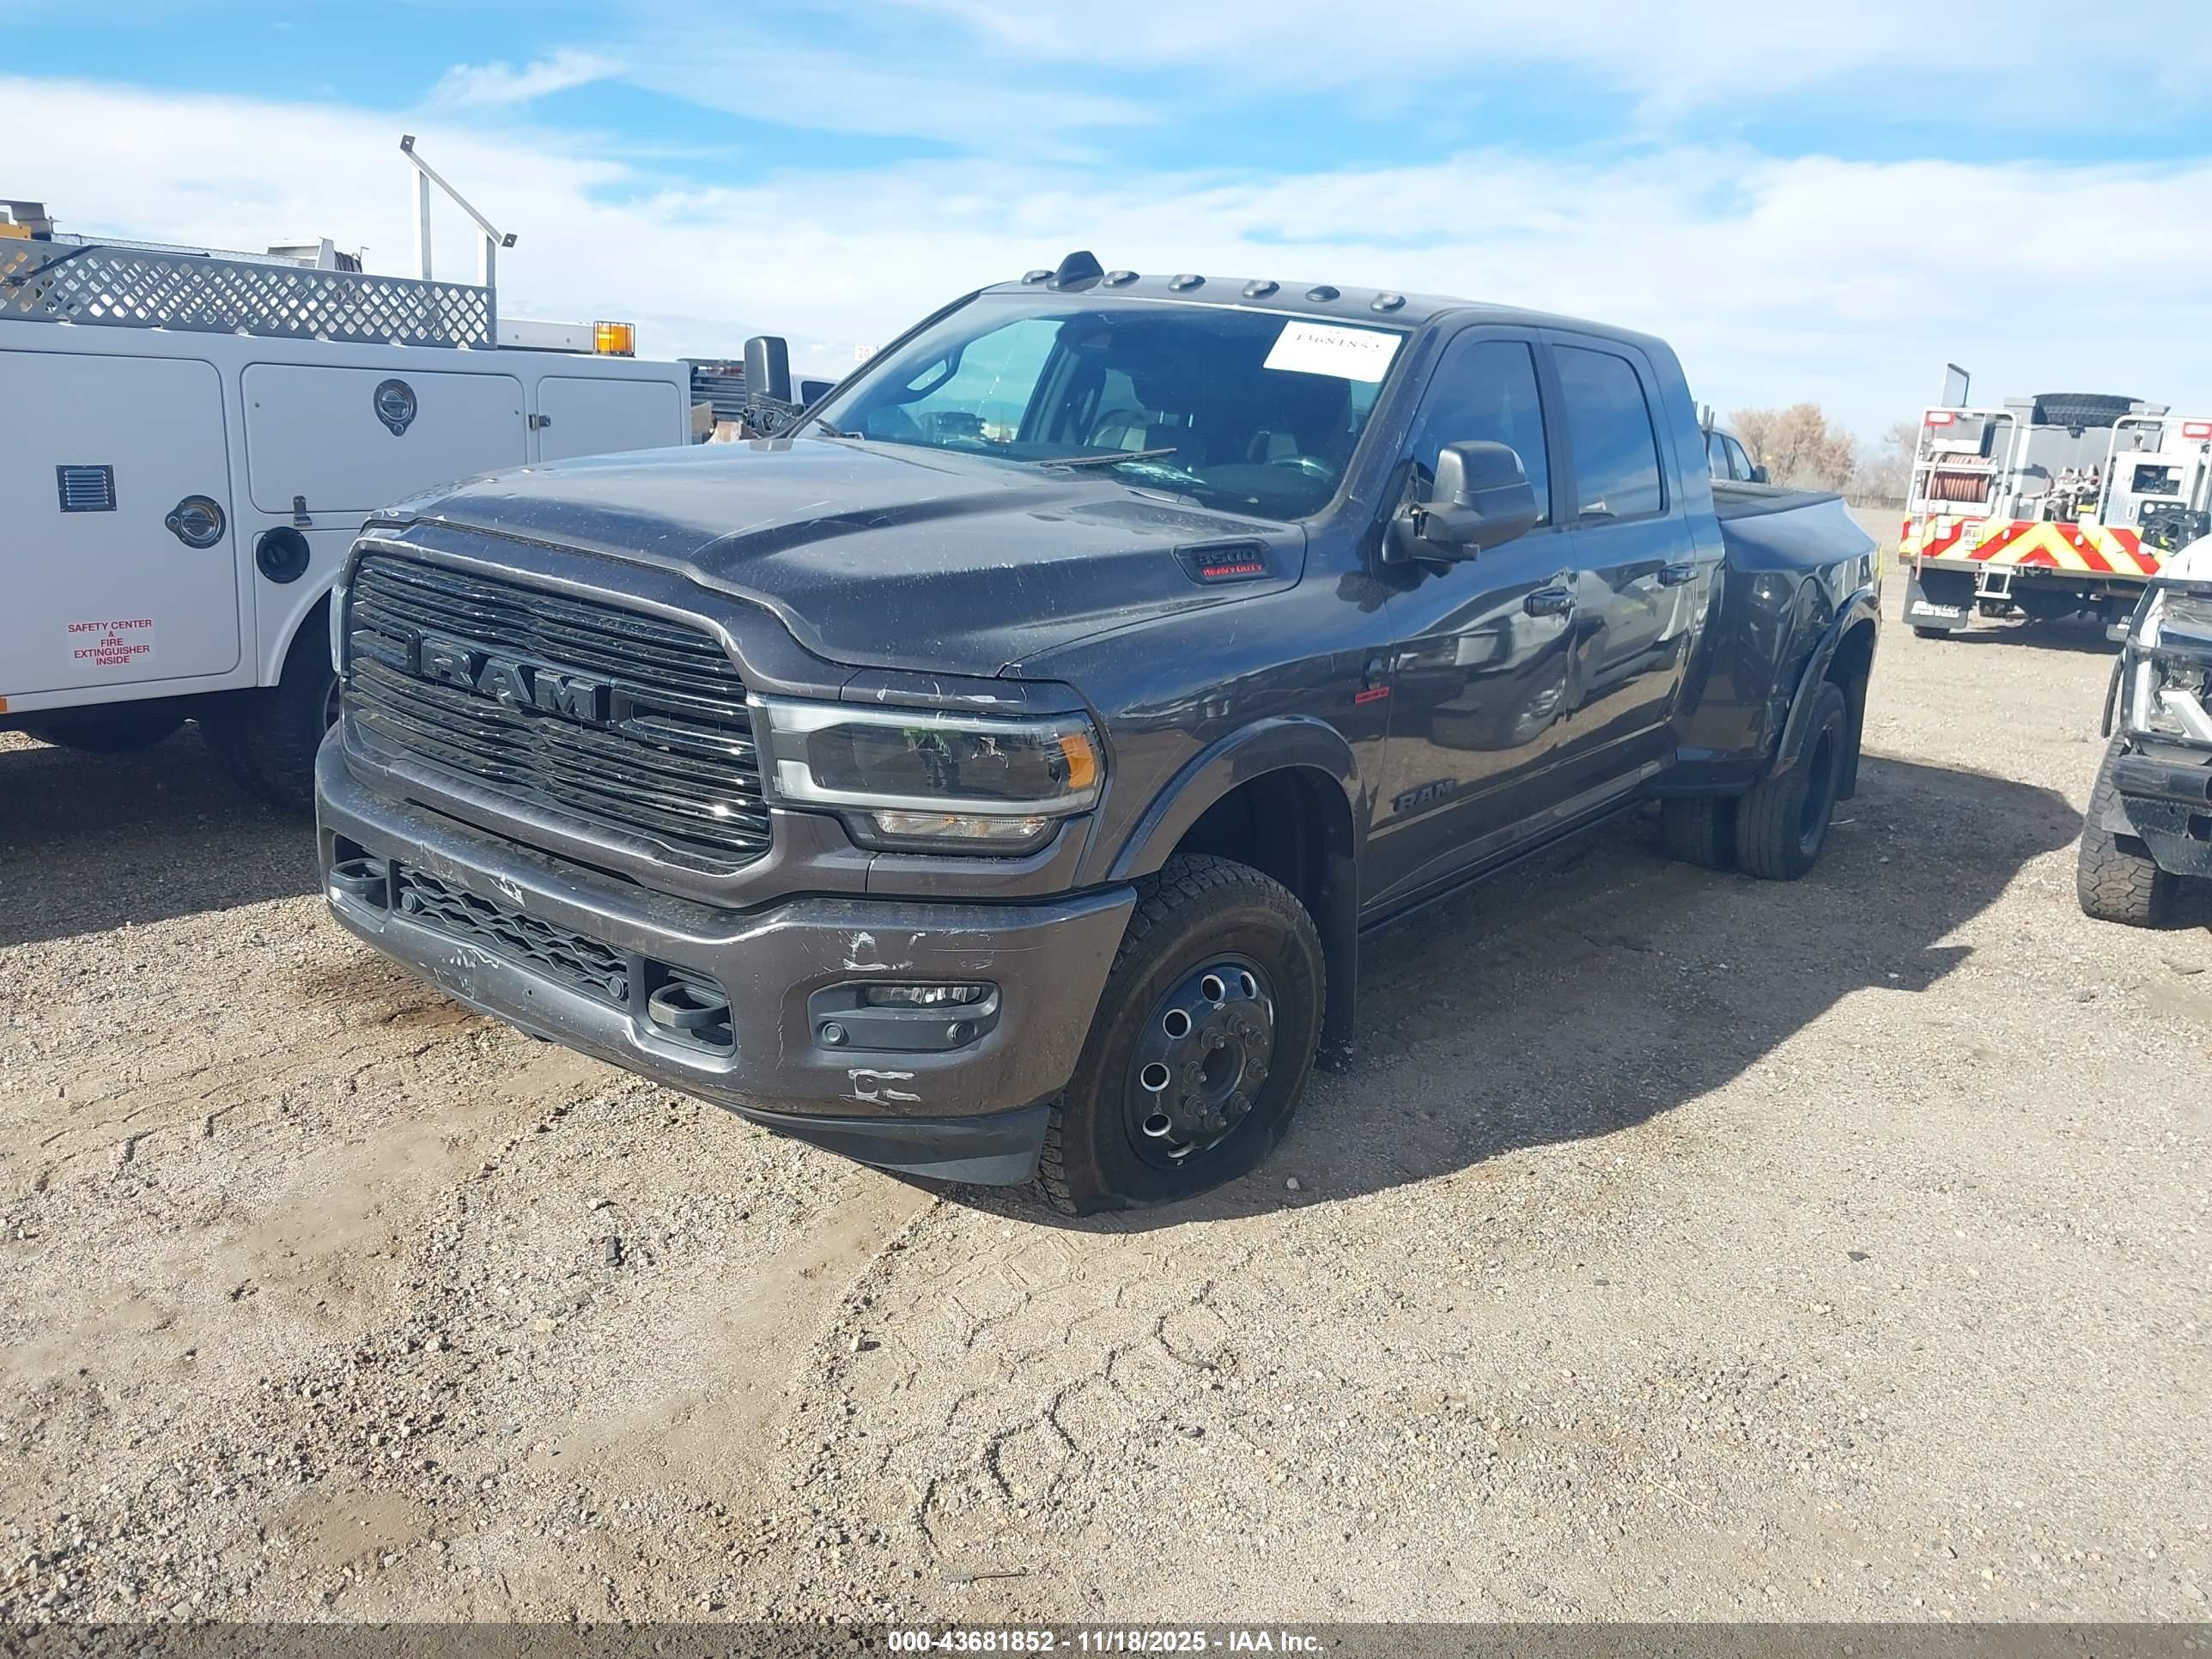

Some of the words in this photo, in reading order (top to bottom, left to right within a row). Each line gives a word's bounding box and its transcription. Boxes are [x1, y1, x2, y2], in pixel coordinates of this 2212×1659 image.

[1202, 566, 1235, 577] HEAVY
[1236, 563, 1262, 573] DUTY
[68, 622, 108, 633] SAFETY
[111, 619, 152, 629] CENTER
[100, 638, 124, 647] FIRE
[74, 645, 149, 659] EXTINGUISHER
[96, 655, 131, 666] INSIDE
[422, 638, 598, 721] RAM
[1394, 778, 1456, 812] RAM
